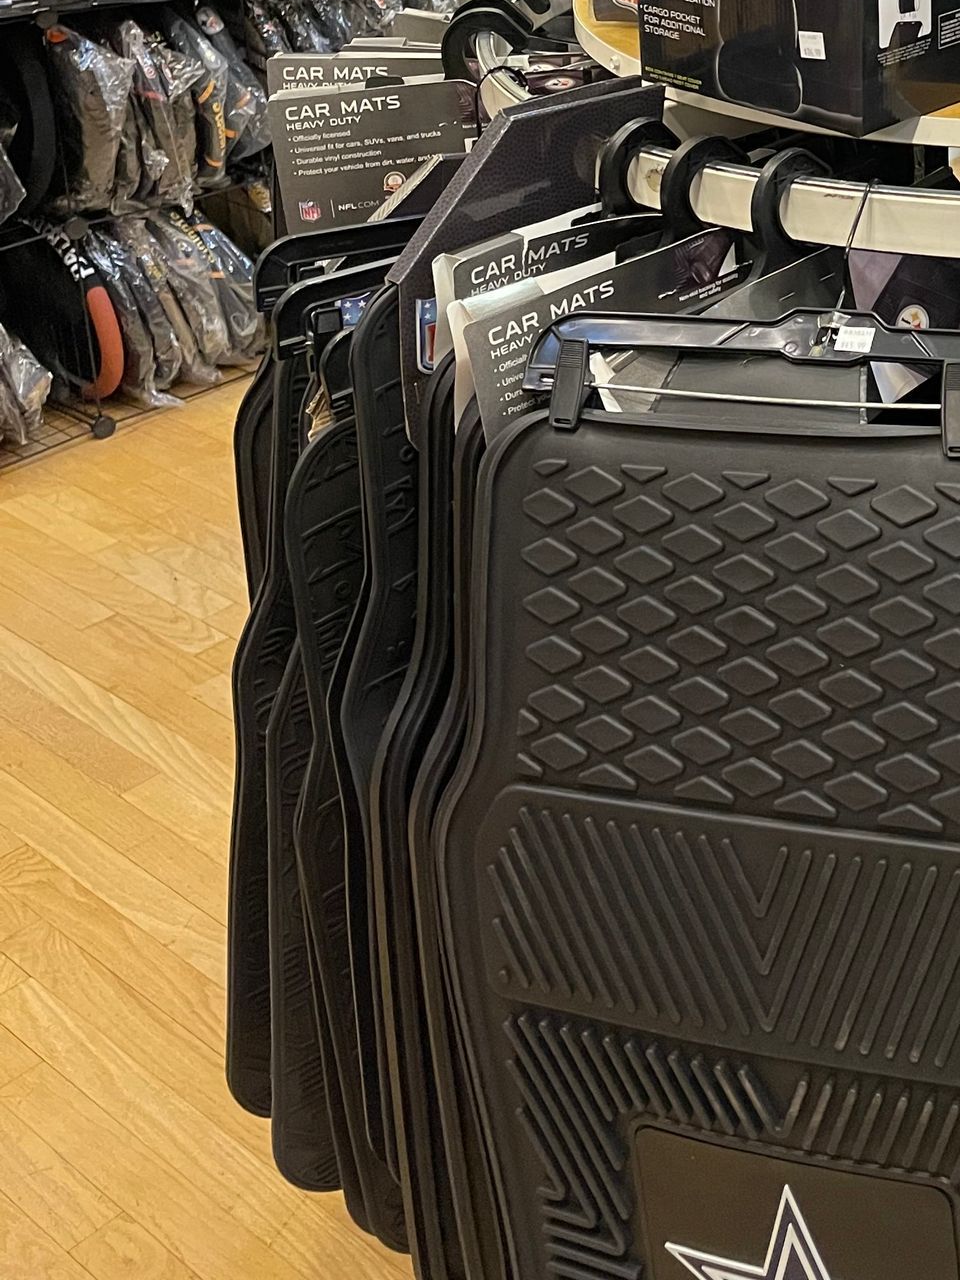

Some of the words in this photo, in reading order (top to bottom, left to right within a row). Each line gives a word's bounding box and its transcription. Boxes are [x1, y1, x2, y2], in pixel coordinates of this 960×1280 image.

[643, 4, 669, 18] CARGO
[670, 9, 701, 25] POCKET
[643, 14, 660, 26] FOR
[660, 17, 706, 37] ADDITIONAL
[644, 24, 681, 40] STORAGE
[282, 66, 324, 81] CAR
[333, 66, 389, 81] MATS
[284, 103, 330, 121] CAR
[340, 94, 401, 115] MATS
[286, 119, 325, 132] HEAVY
[329, 115, 362, 127] DUTY
[292, 132, 322, 143] Officially
[321, 129, 351, 141] licensed
[293, 143, 327, 155] Universal
[327, 142, 335, 152] fit
[334, 140, 345, 151] for
[406, 132, 420, 142] and
[420, 128, 442, 140] trucks
[296, 154, 324, 166] Durable
[323, 152, 341, 164] vinyl
[341, 148, 382, 161] construction
[298, 166, 323, 178] Protect
[323, 164, 339, 176] your
[339, 161, 365, 172] vehicle
[364, 159, 381, 170] from
[470, 254, 517, 286] CAR
[526, 232, 591, 266] MATS
[513, 261, 547, 283] DUTY
[487, 311, 540, 346] CAR
[549, 279, 616, 320] MATS
[490, 333, 535, 360] HEAVY
[507, 397, 536, 416] Protect
